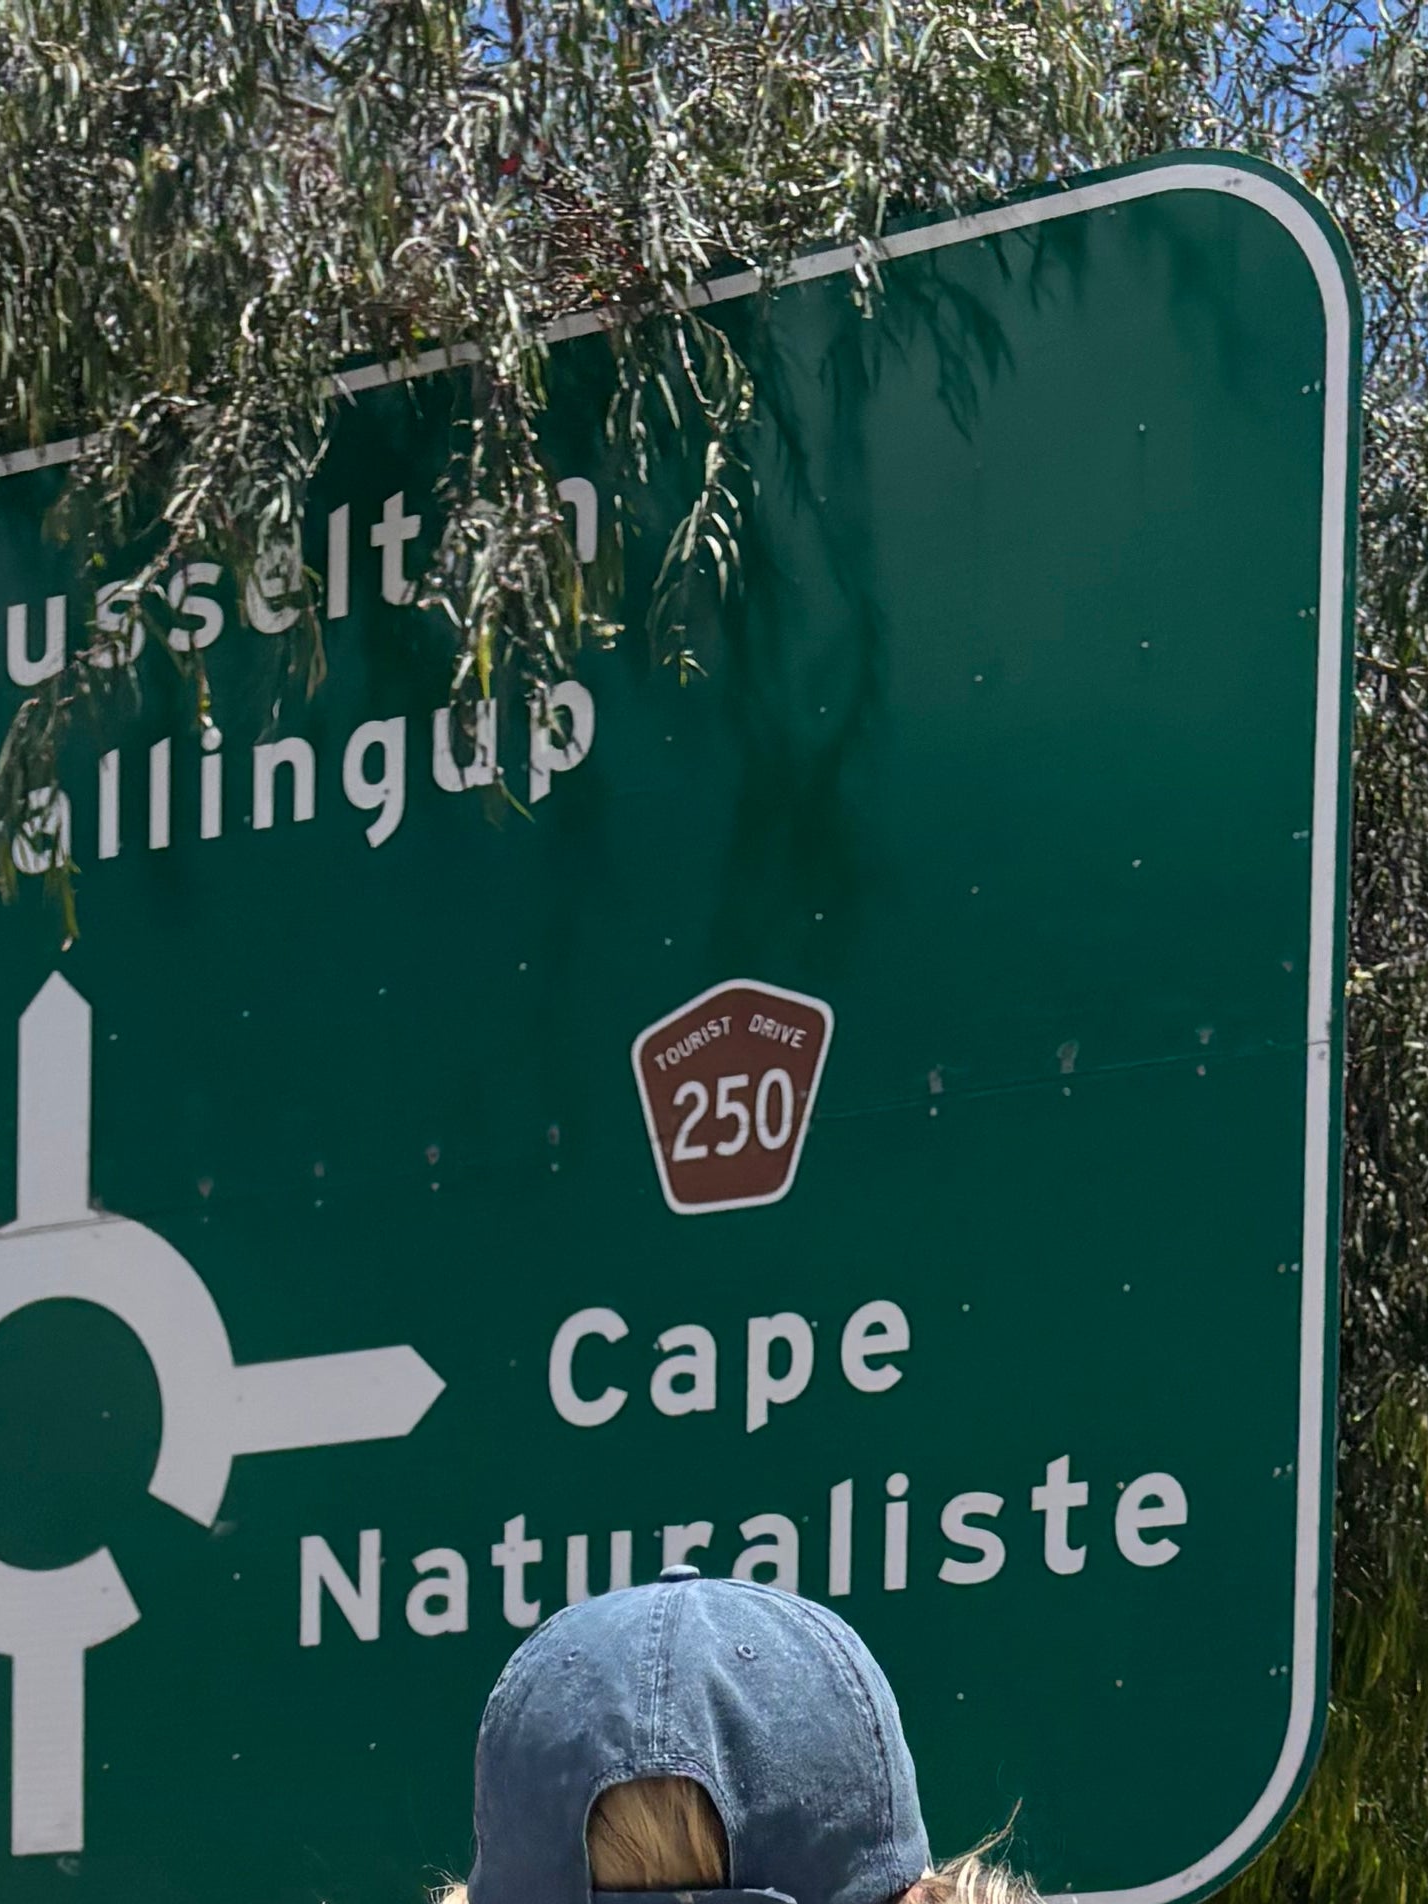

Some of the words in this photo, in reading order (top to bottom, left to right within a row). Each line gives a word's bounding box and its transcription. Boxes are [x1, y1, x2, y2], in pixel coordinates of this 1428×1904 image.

[653, 1015, 733, 1072] TOURIST
[747, 1013, 808, 1049] DRIVE
[671, 1067, 795, 1163] 250
[547, 1299, 912, 1434] Cape
[298, 1453, 1189, 1648] Naturaliste
